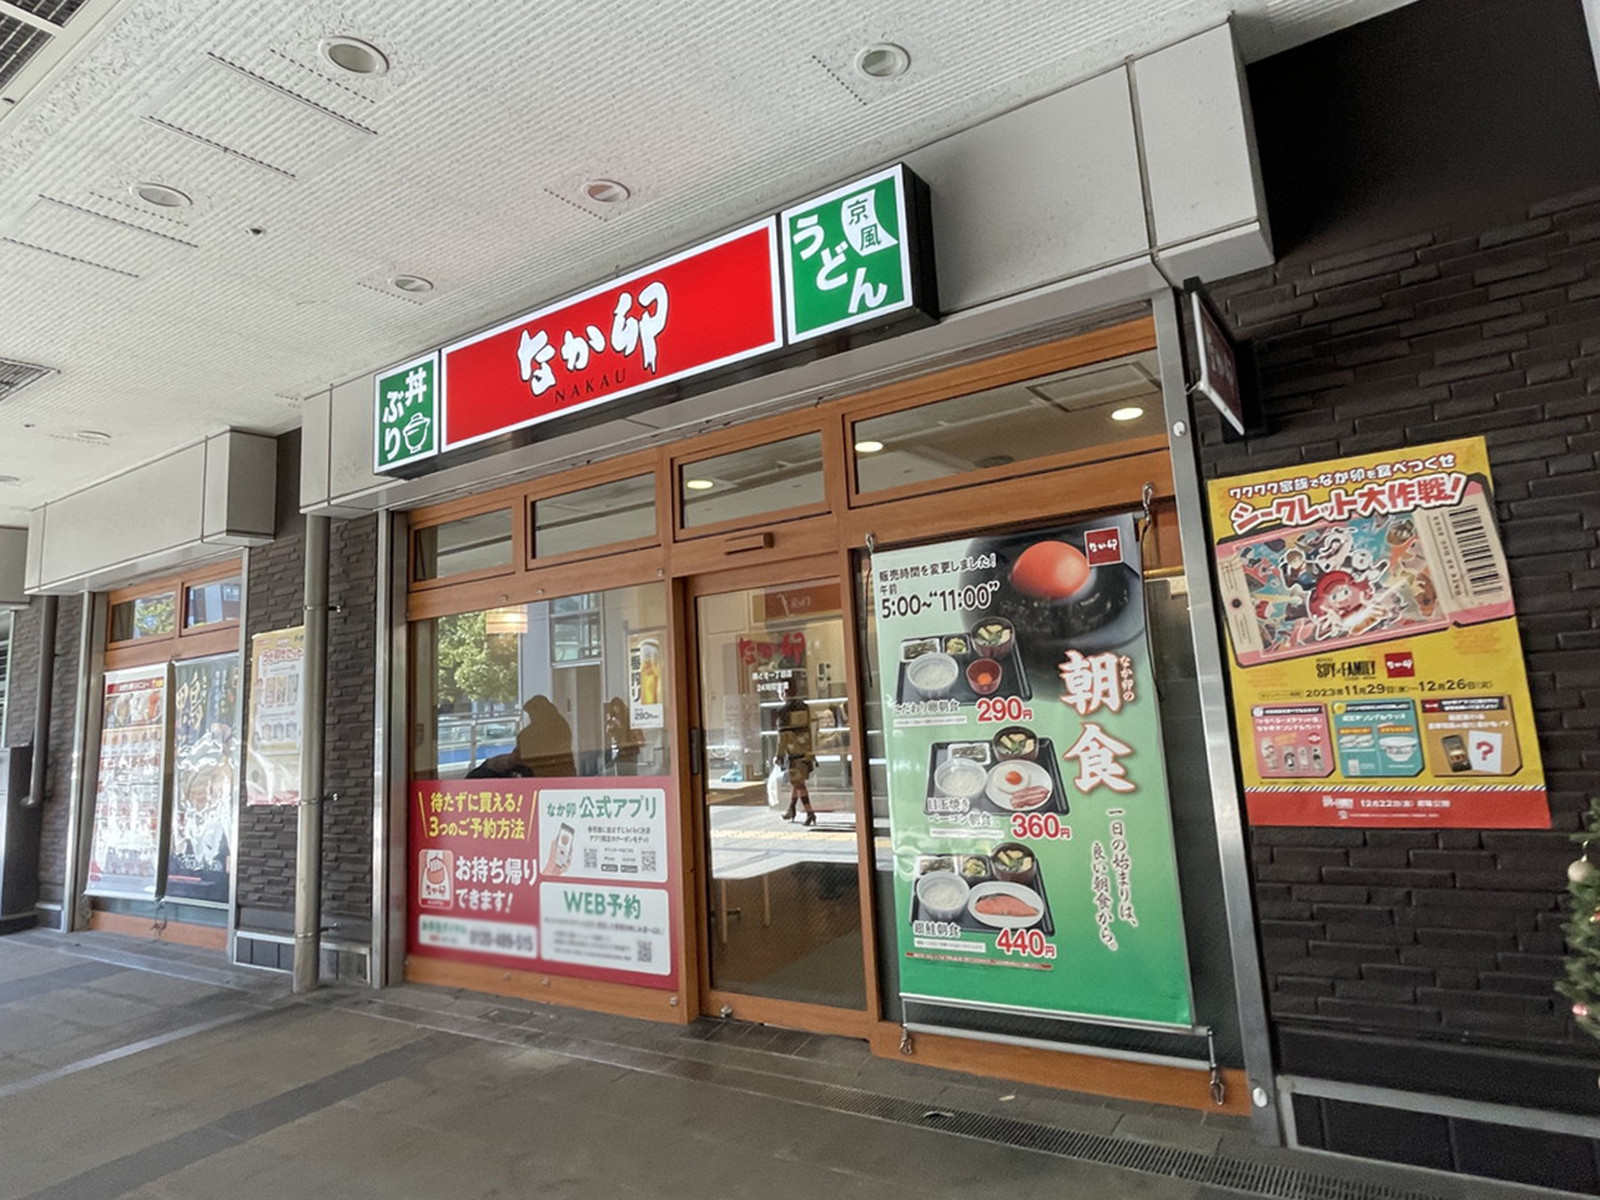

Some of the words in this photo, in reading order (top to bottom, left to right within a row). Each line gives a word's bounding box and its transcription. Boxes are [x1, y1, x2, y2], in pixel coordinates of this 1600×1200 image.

[847, 199, 883, 252] 京風
[793, 214, 887, 314] うどん
[517, 281, 670, 396] なか卯
[553, 368, 628, 403] NAKAU
[1229, 454, 1456, 499] ワクワク家族でなか卯を食べつくせ
[1231, 474, 1466, 533] シークレット大作戦!
[1089, 538, 1119, 553] なか卯
[880, 584, 898, 595] 午前
[1119, 655, 1135, 702] なか卯の
[977, 697, 1033, 722] 290円
[1060, 650, 1137, 792] 朝食
[430, 791, 523, 813] 待たずに買える!
[579, 795, 656, 819] 公式アプリ
[429, 816, 525, 840] 3つのご予約方法
[1012, 813, 1072, 839] 360円
[455, 855, 538, 886] お持ち帰り
[1108, 808, 1139, 928] 一日の始まりは、
[455, 888, 513, 913] できます!
[563, 891, 641, 920] WEB予約
[1091, 842, 1118, 951] 良い朝食から。
[997, 928, 1056, 957] 440円
